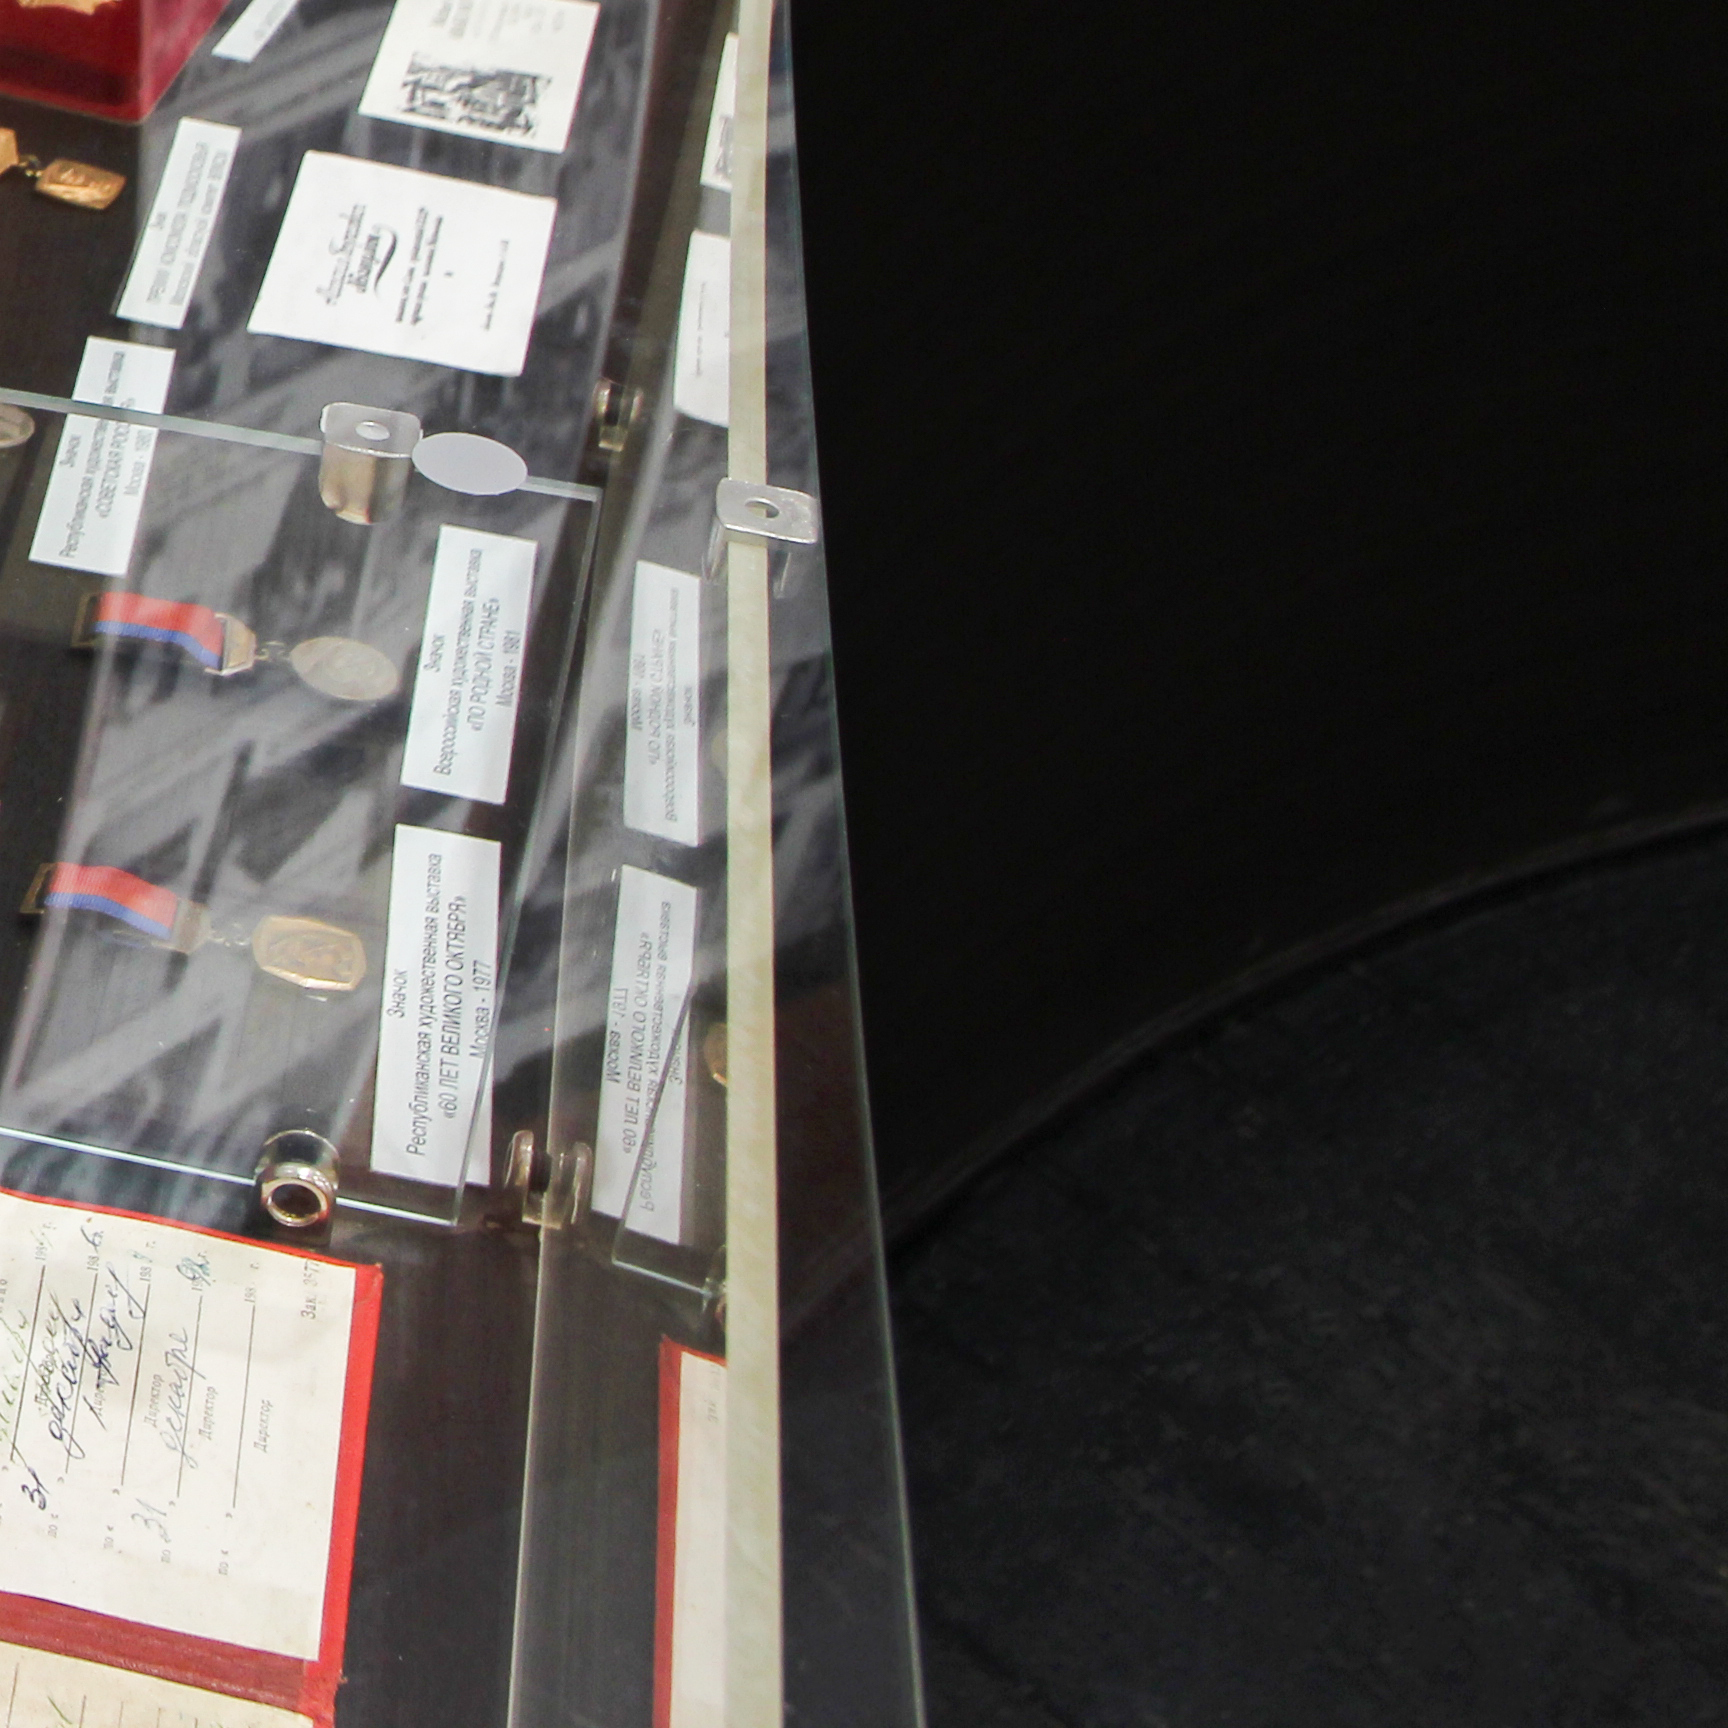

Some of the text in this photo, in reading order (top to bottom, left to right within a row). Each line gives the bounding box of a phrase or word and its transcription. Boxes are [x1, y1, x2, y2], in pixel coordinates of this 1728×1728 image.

[469, 651, 492, 704] РОДНОЙ
[386, 970, 408, 1019] Значок
[406, 853, 442, 1156] Республиканская художественная выставка
[437, 896, 466, 1119] «60 ЛЕТ ВЕЛИКОГО ОКТЯБРЯ»
[469, 958, 493, 1061] Москва 1977
[197, 1385, 218, 1440] Директор
[253, 1399, 274, 1453] Директор
